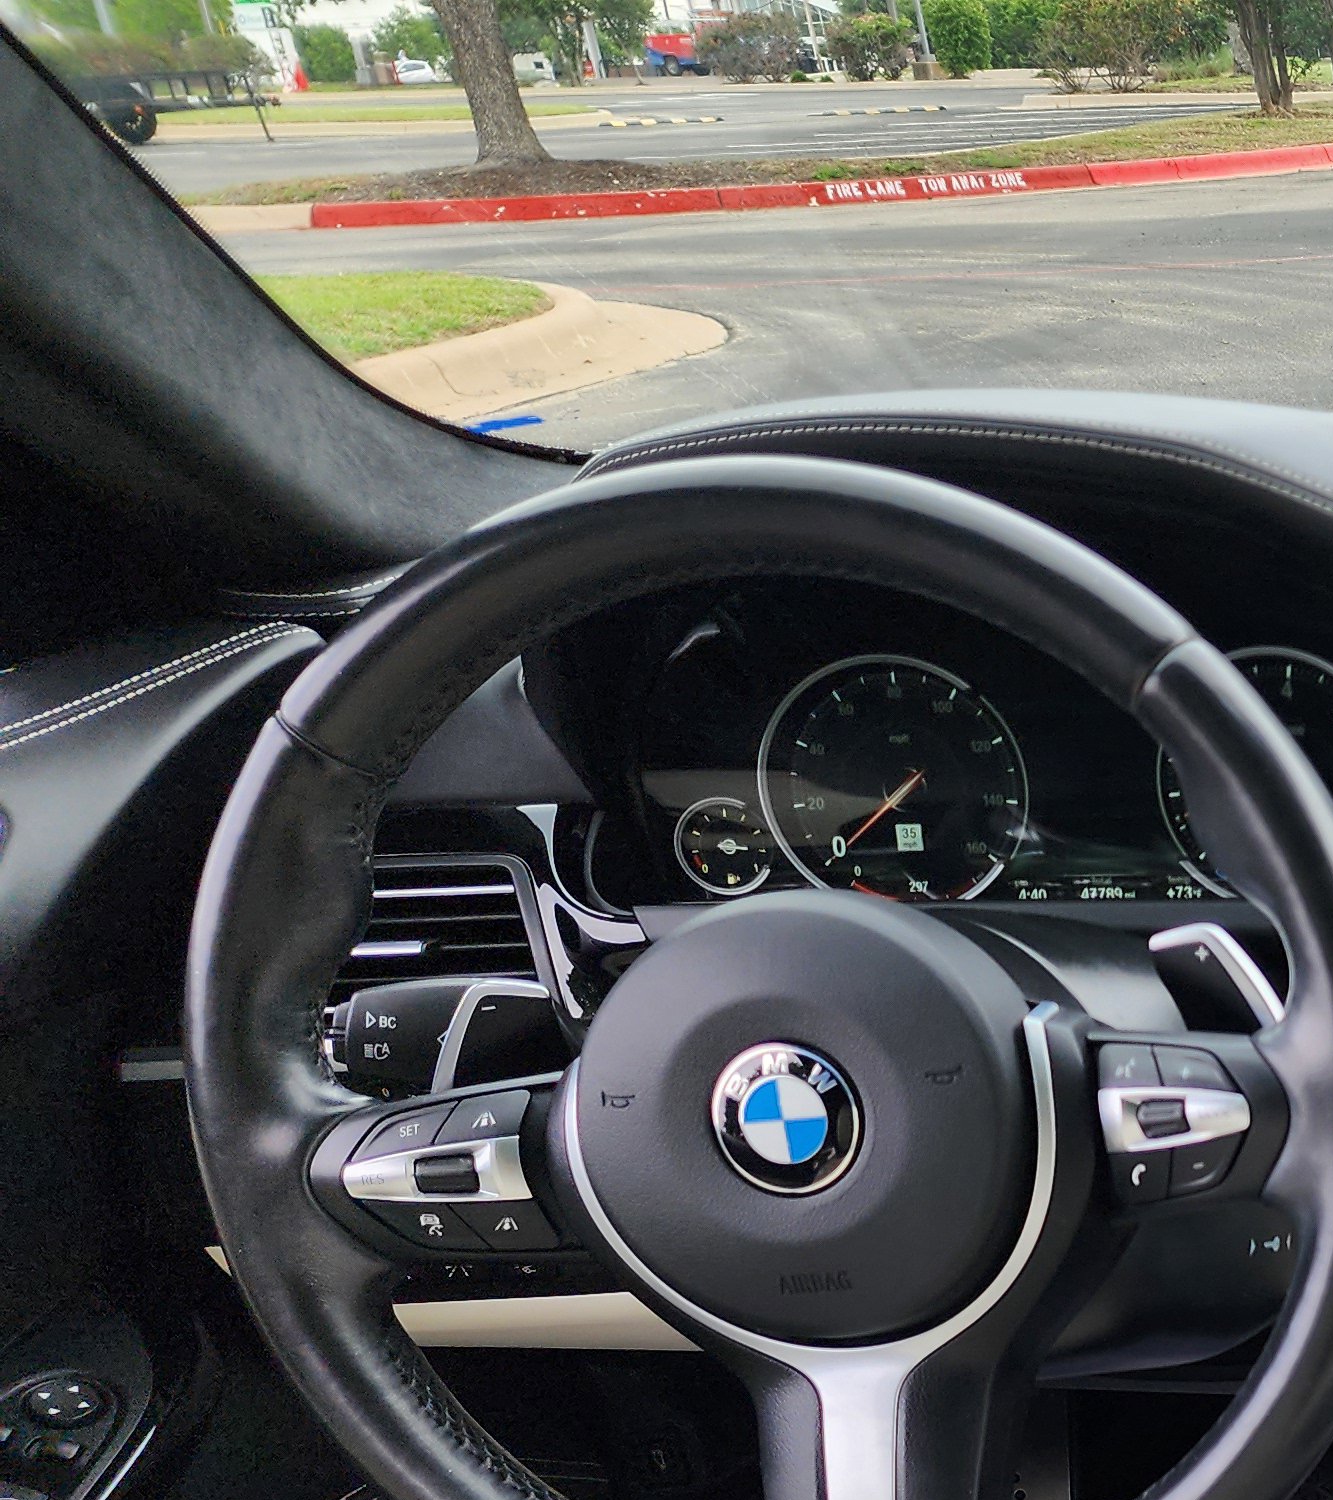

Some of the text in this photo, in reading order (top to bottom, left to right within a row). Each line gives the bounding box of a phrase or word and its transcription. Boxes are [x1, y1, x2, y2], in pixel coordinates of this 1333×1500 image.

[825, 182, 863, 200] FIRE
[864, 180, 906, 196] LANE
[988, 171, 1027, 189] ZONE
[1281, 680, 1293, 698] 4
[807, 797, 825, 811] 20
[902, 827, 917, 839] 35
[832, 836, 847, 858] 0
[854, 865, 862, 877] 0
[909, 881, 929, 893] 297
[378, 1015, 397, 1030] BC
[724, 1051, 838, 1102] BMW
[399, 1123, 420, 1138] SET
[360, 1174, 385, 1185] RES
[779, 1271, 852, 1296] AIRBAG
